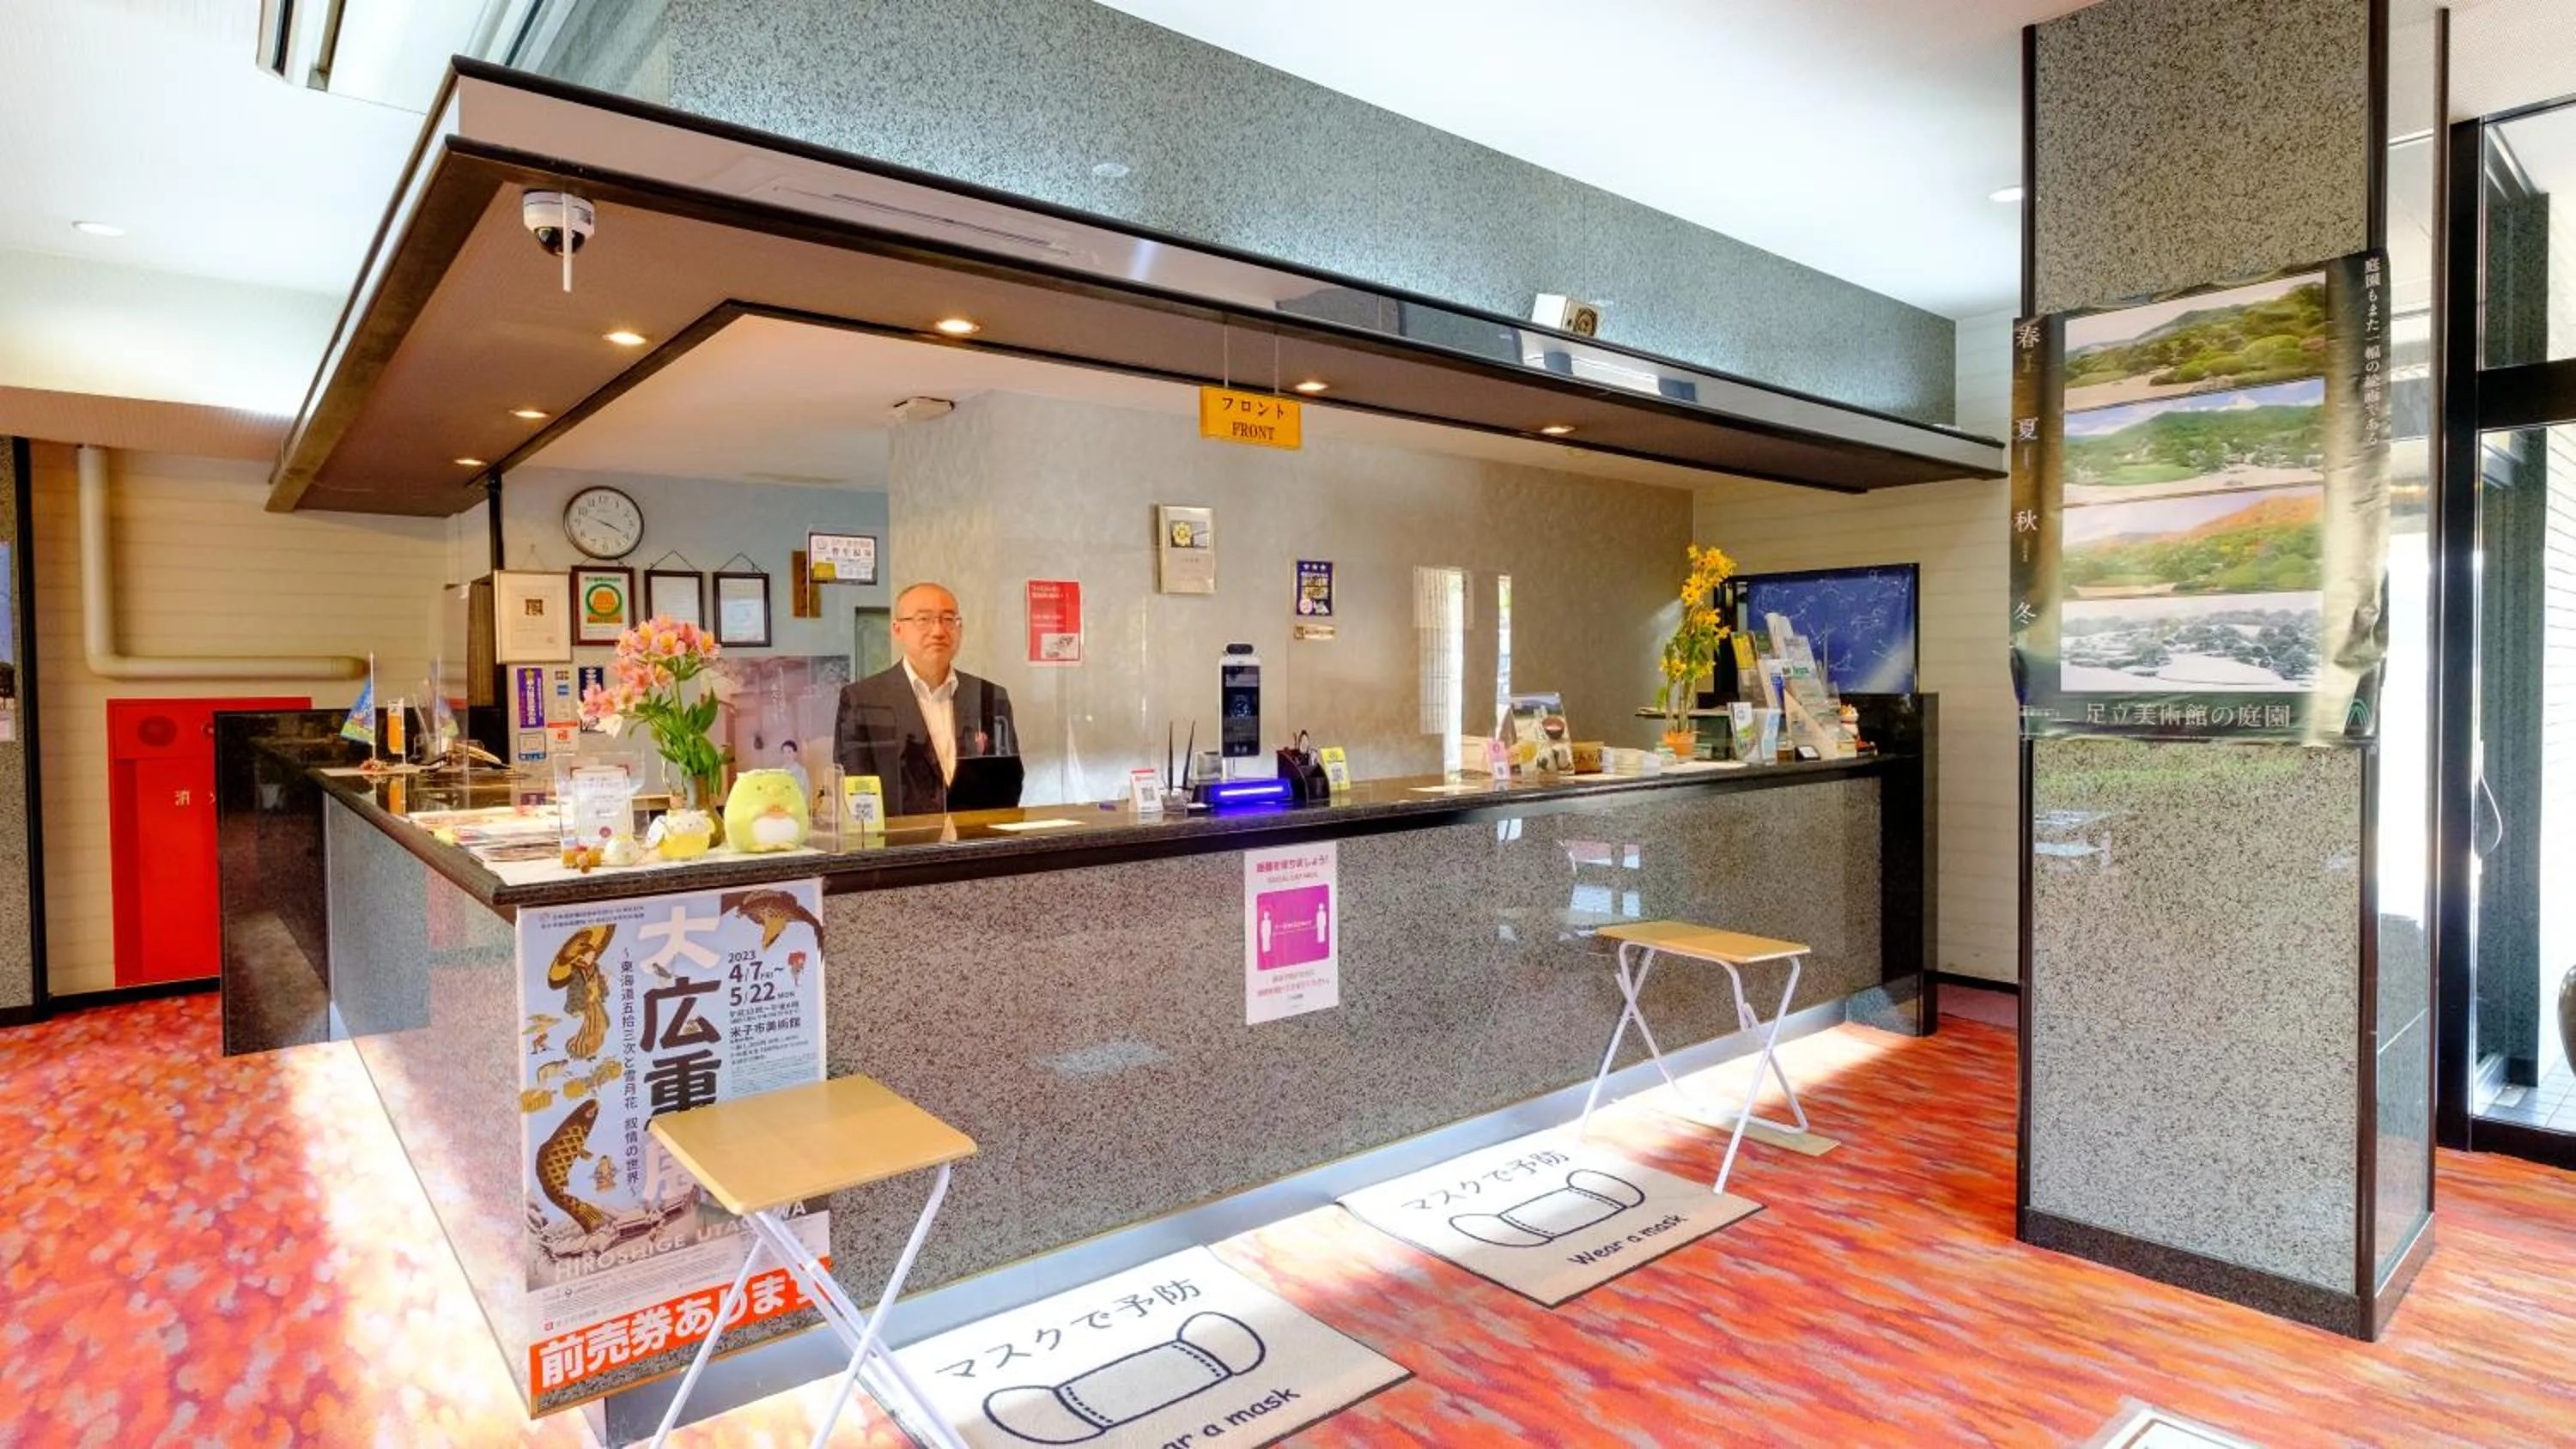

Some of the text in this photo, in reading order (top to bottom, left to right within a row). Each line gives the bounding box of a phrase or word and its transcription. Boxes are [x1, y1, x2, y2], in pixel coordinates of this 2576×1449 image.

[2017, 325, 2041, 349] 春
[1222, 397, 1285, 420] フロント
[1232, 421, 1275, 440] FRONT
[2017, 417, 2039, 440] 夏
[2014, 509, 2038, 533] 秋
[2014, 602, 2038, 624] 冬
[2086, 702, 2291, 728] 足立美術館の庭園
[727, 949, 756, 963] 2023
[728, 961, 763, 983] 4/7
[729, 981, 775, 1006] 5/22
[730, 1017, 801, 1037] 米子市美術館
[1401, 1149, 1571, 1211] マスクで予防
[696, 1202, 807, 1241] UTAA
[1566, 1240, 1624, 1264] Wear
[1637, 1215, 1689, 1237] mask
[935, 1278, 1201, 1378] マスクで予防
[1203, 1423, 1225, 1437] a
[1224, 1387, 1301, 1426] mask
